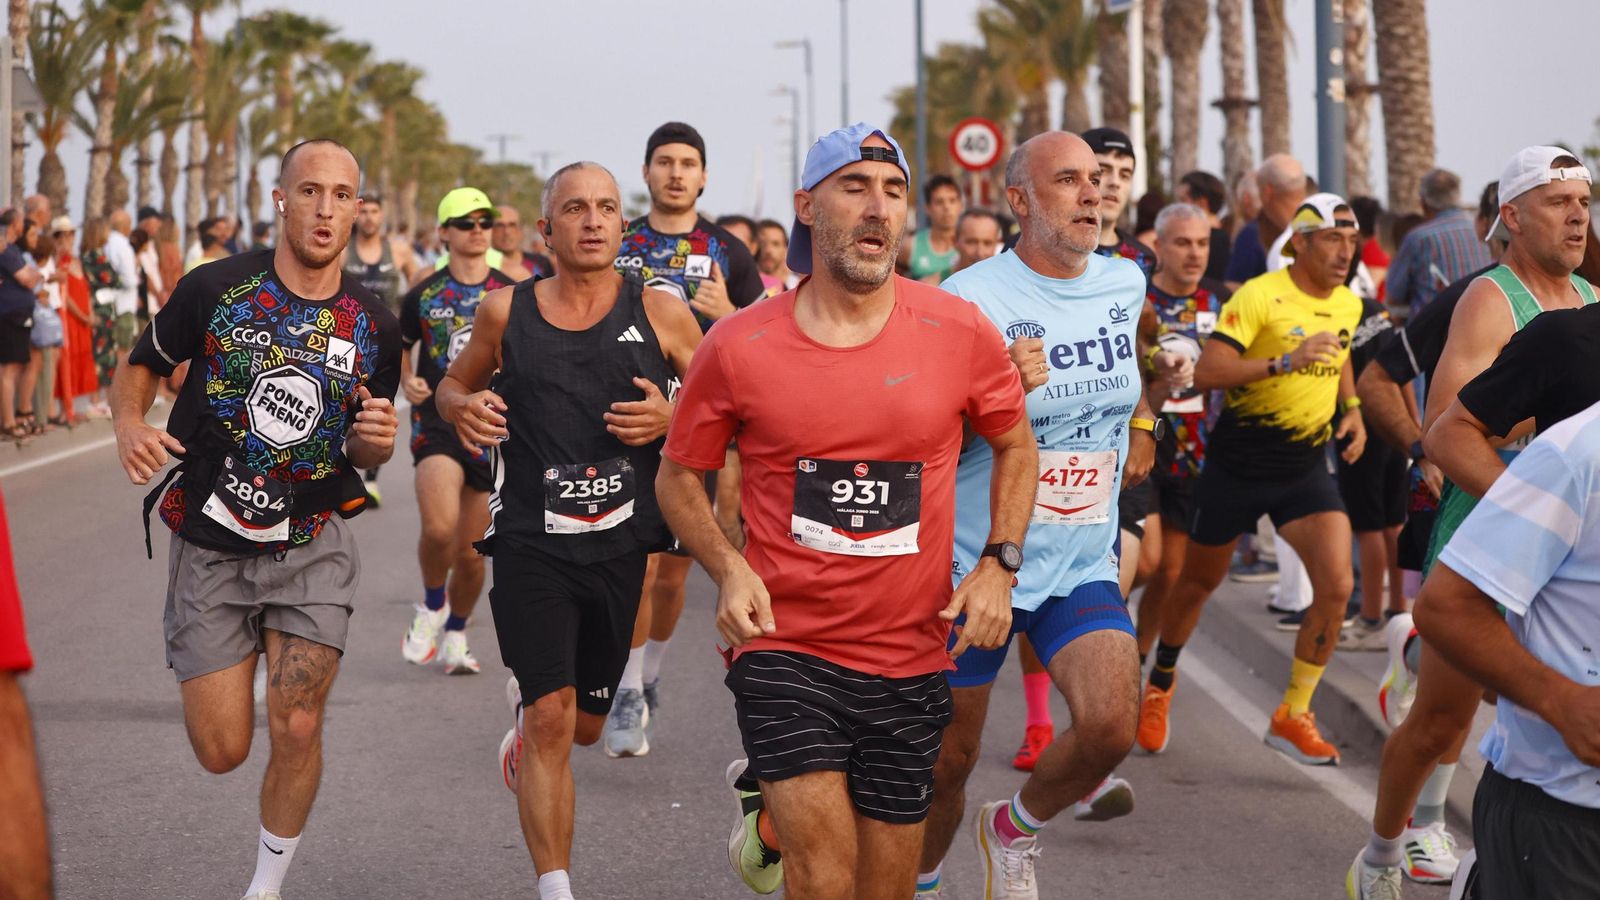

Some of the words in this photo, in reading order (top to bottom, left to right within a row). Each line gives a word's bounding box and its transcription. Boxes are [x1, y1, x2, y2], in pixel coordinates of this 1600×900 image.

[963, 132, 989, 153] 40
[1008, 323, 1044, 339] TROPS
[326, 353, 349, 370] AXA
[1049, 326, 1133, 373] erja
[324, 368, 352, 381] fundación
[1043, 374, 1130, 401] ATLETISMO
[264, 382, 316, 419] PONLE
[256, 396, 307, 432] FRENO
[559, 474, 623, 498] 2385
[1039, 468, 1099, 487] 4172
[225, 473, 286, 512] 2804
[831, 479, 890, 506] 931
[805, 525, 824, 535] 0074
